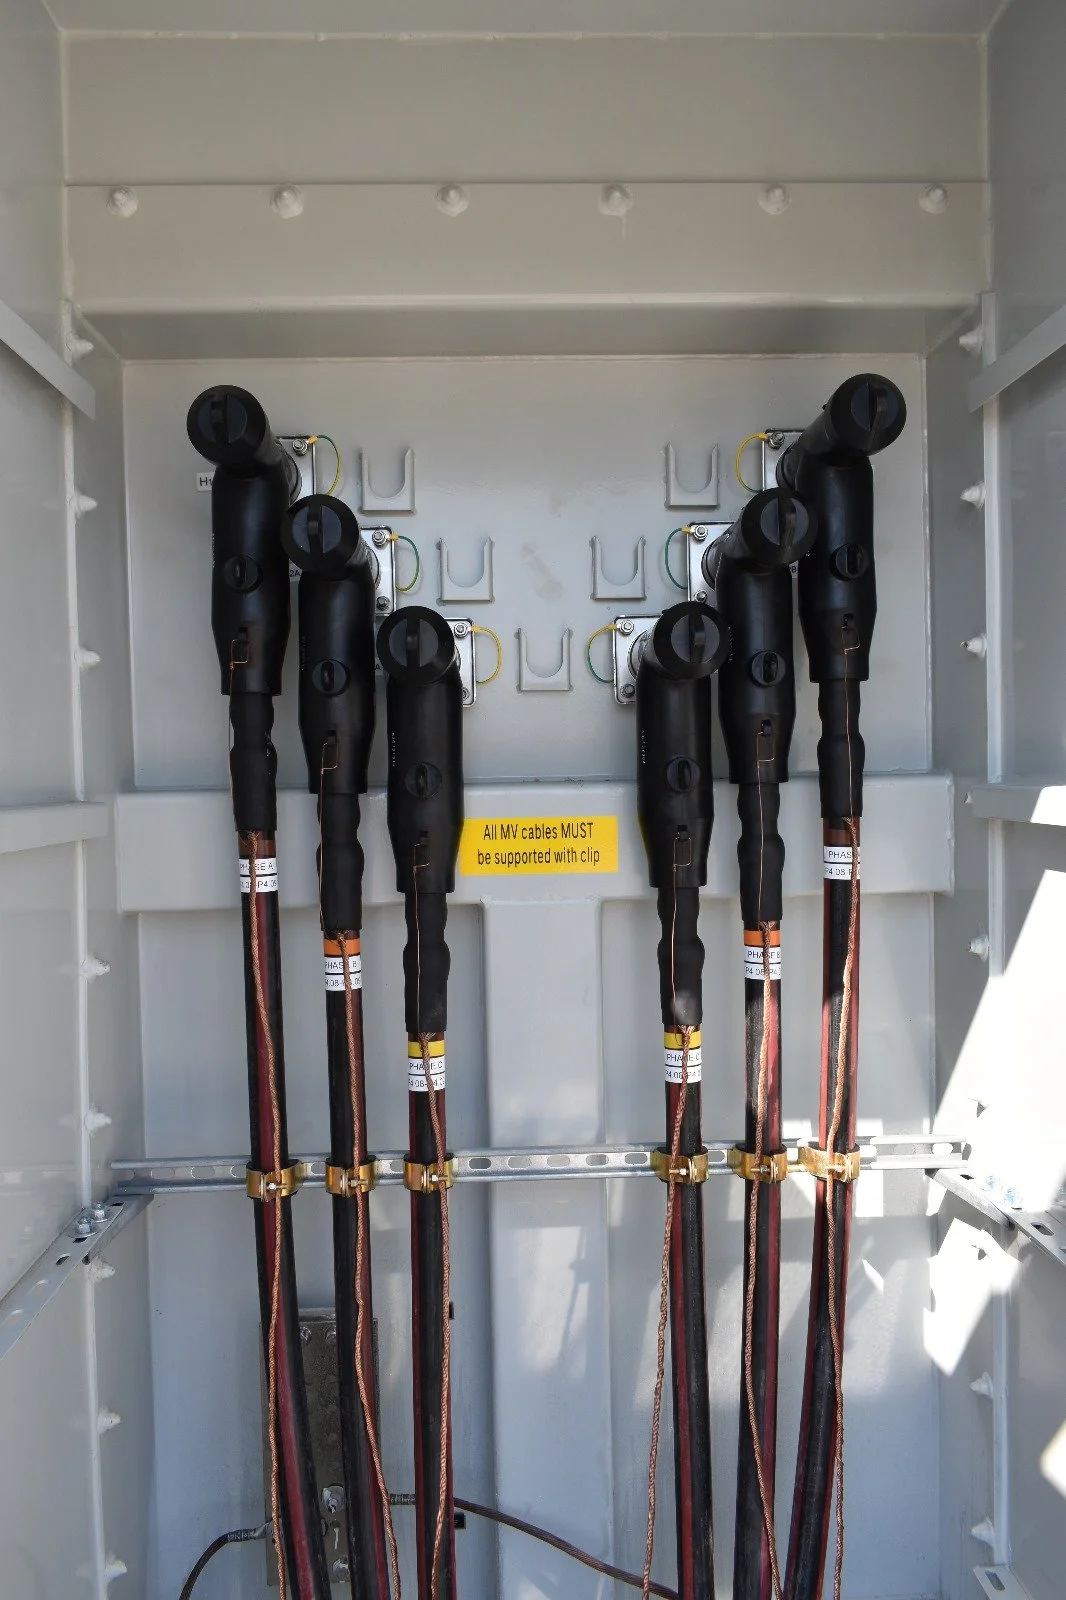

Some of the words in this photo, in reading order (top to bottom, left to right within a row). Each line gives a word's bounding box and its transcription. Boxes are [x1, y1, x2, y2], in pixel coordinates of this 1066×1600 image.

[483, 824, 497, 840] All
[500, 823, 518, 840] MV
[521, 823, 558, 840] cables
[561, 822, 594, 839] MUST
[477, 848, 491, 865] be
[494, 848, 551, 868] supported
[554, 847, 577, 863] with
[580, 846, 600, 866] clip
[828, 850, 853, 859] PHAS
[325, 961, 350, 970] PHAS
[666, 1053, 694, 1062] PHAE
[409, 1062, 437, 1071] PHAE
